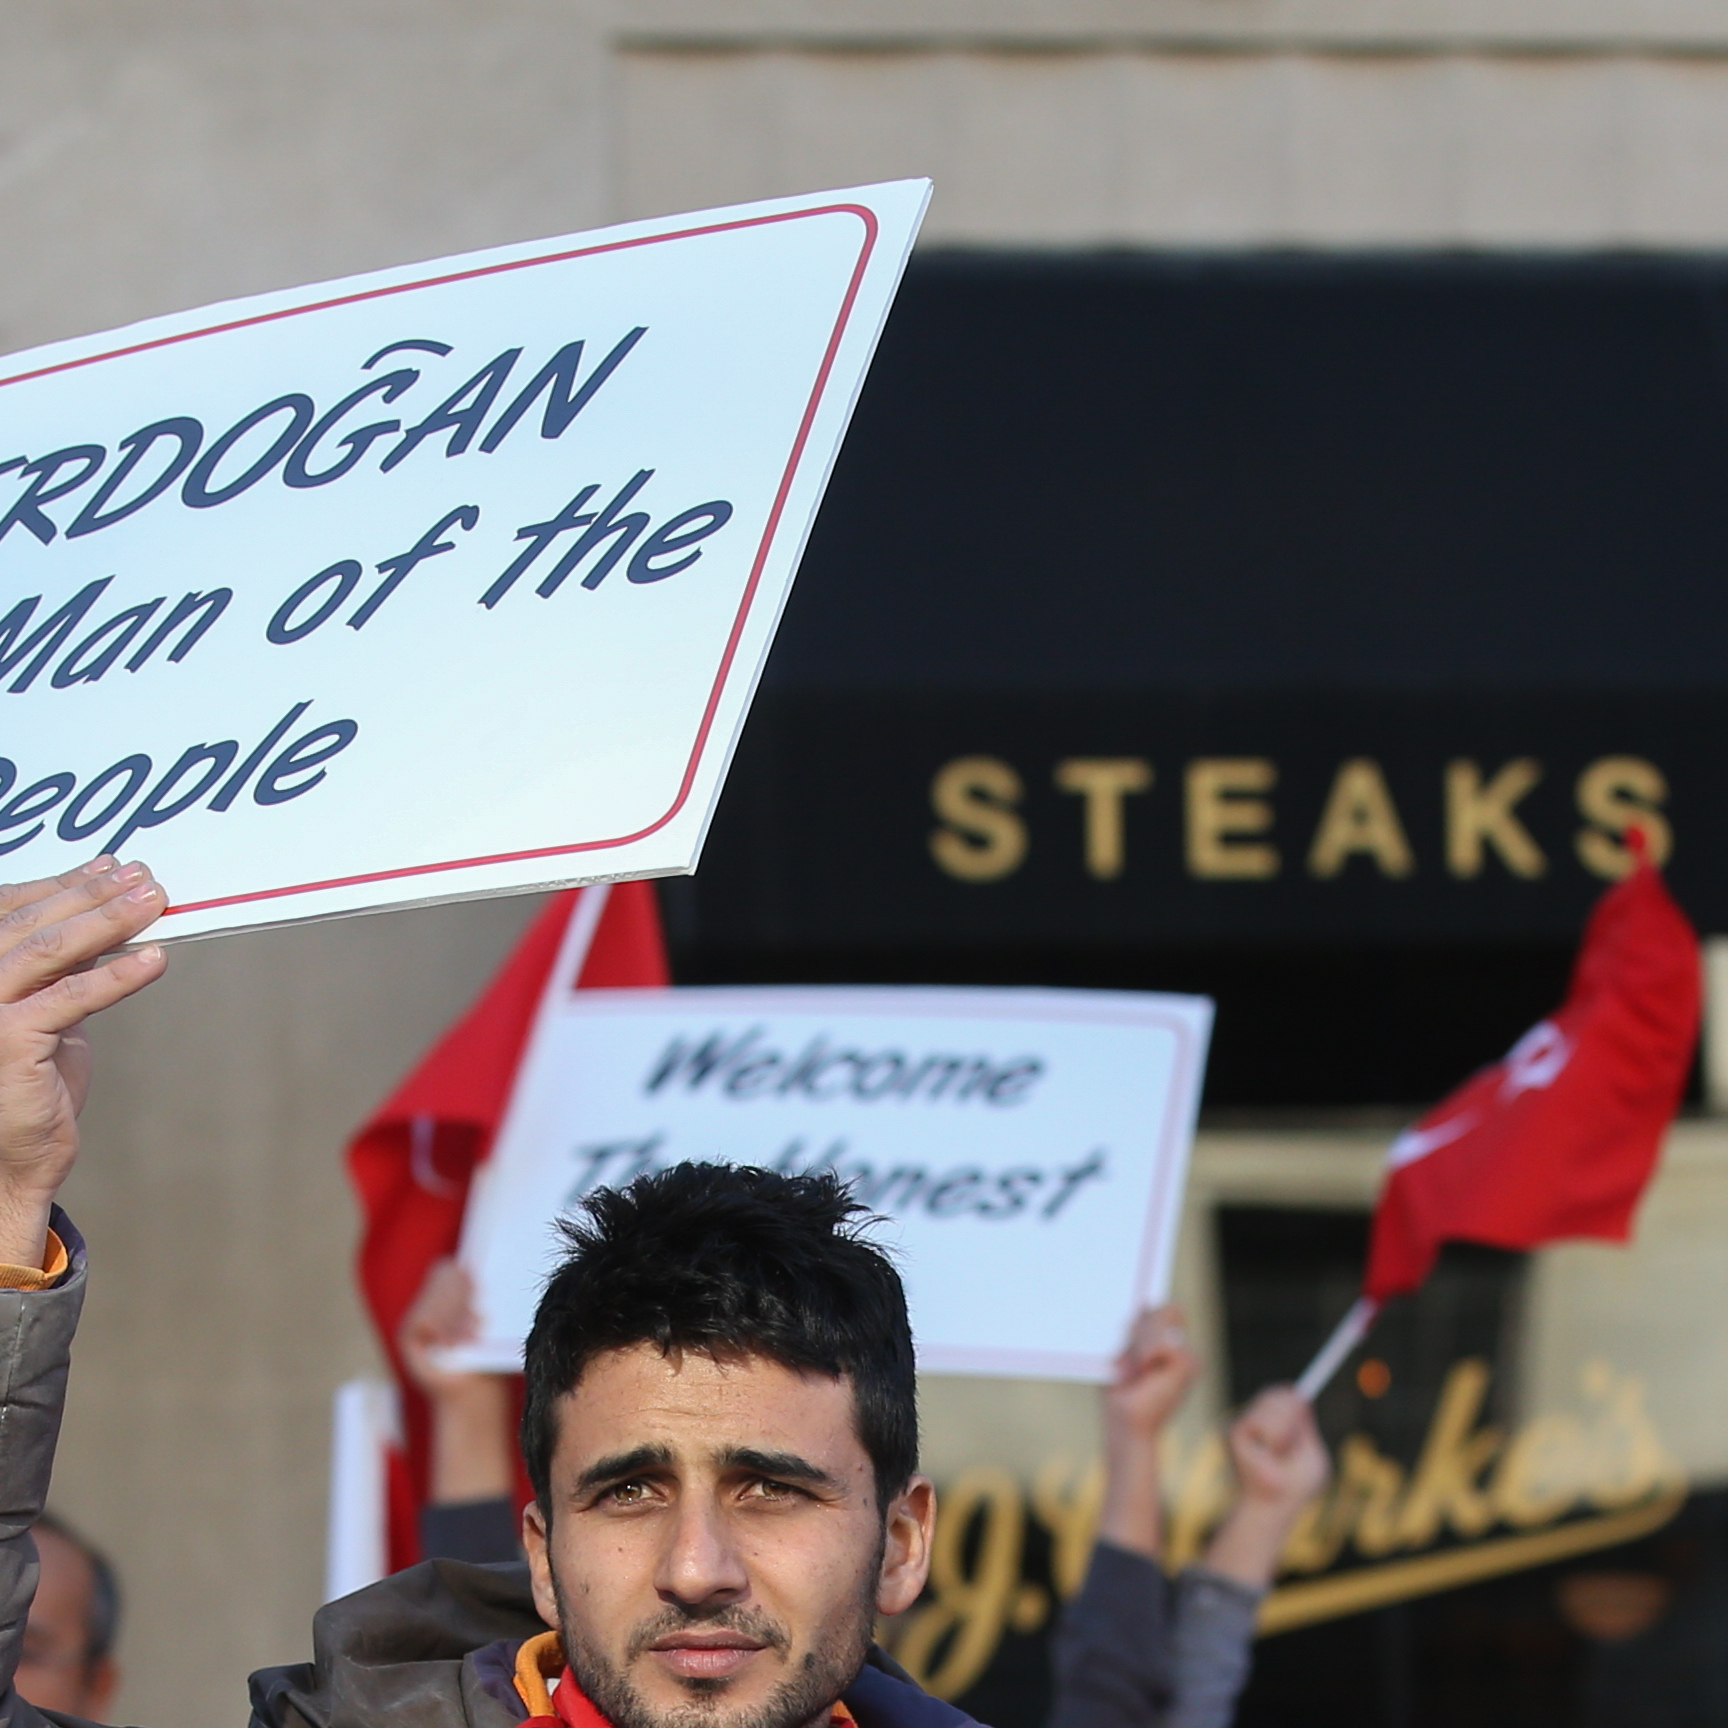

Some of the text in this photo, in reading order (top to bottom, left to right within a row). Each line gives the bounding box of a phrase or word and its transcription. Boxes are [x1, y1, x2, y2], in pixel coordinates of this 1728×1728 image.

[266, 505, 480, 645] of
[477, 467, 733, 610] the
[929, 758, 1672, 880] STEAKS
[642, 1022, 1045, 1107] Welcome
